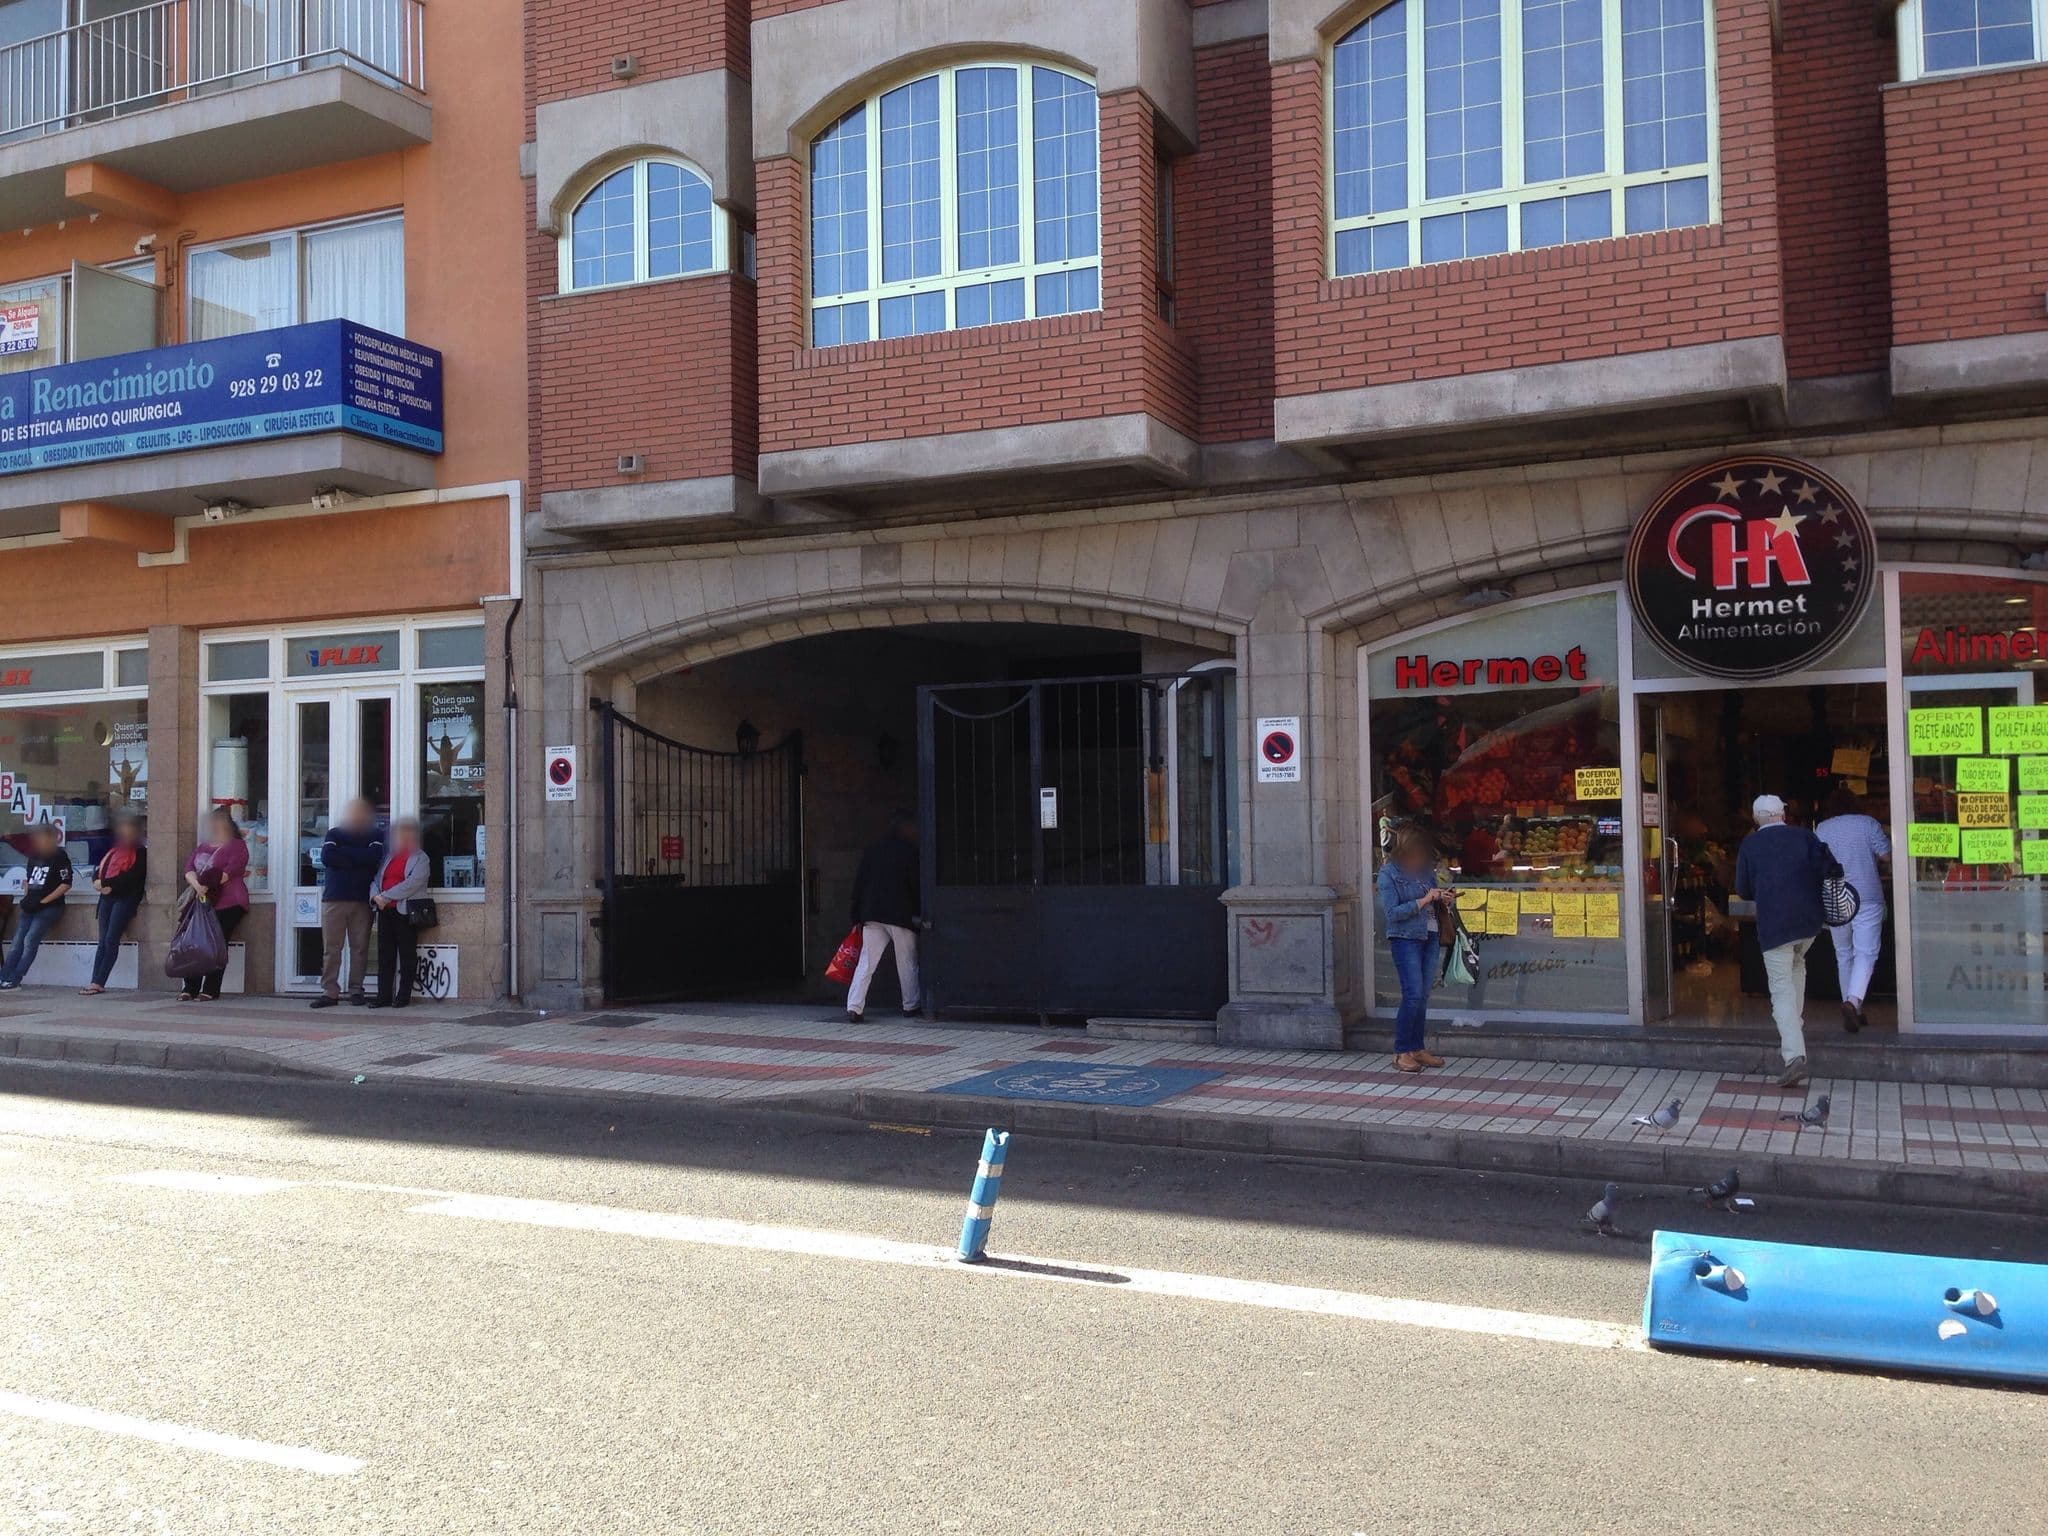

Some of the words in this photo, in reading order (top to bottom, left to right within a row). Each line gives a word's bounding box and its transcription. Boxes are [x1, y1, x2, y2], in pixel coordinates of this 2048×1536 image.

[354, 348, 404, 372] REJUVENECIMIENTO
[405, 364, 423, 379] FACIAL
[354, 363, 381, 382] OBESIDAD
[34, 358, 215, 415] Renacimiento
[230, 378, 256, 399] 928
[260, 375, 278, 394] 29
[282, 372, 300, 391] 03
[304, 369, 322, 388] 22
[354, 379, 380, 396] CELULITIS
[384, 388, 394, 400] LPG
[2, 428, 15, 443] DE
[17, 418, 63, 441] ESTÉTICA
[66, 412, 109, 433] MÉDICO
[112, 402, 183, 427] QUIRÚRGICA
[43, 446, 77, 463] OBESIDAD
[78, 445, 85, 458] Y
[85, 435, 125, 457] NUTRICIÓN
[136, 432, 171, 450] CELULITIS
[178, 429, 192, 444] LPG
[200, 419, 251, 441] LIPOSUCCIÓN
[264, 412, 297, 433] CIRUGÍA
[300, 409, 335, 428] ESTÉTICA
[383, 423, 435, 447] Renacimiento
[1690, 593, 1808, 619] Hermet
[1677, 617, 1823, 641] Alimentación
[320, 645, 383, 667] FLEX
[1395, 645, 1587, 690] Hermet
[432, 695, 456, 706] Quien
[457, 696, 475, 705] gana
[432, 706, 440, 714] la
[1915, 712, 1974, 721] OFERTA
[114, 723, 134, 735] Quien
[1914, 723, 1939, 740] FILETE
[1941, 723, 1975, 739] ABADEJO
[1995, 722, 2028, 738] CHULETA
[1928, 741, 1962, 752] 1,99
[1596, 779, 1602, 787] DE
[1604, 779, 1619, 787] POLLO
[1960, 805, 1979, 813] MUSLO
[1980, 804, 1989, 813] DE
[1990, 804, 2008, 813] POLLO
[1969, 796, 2005, 804] OFERTON
[1487, 950, 1566, 980] atención
